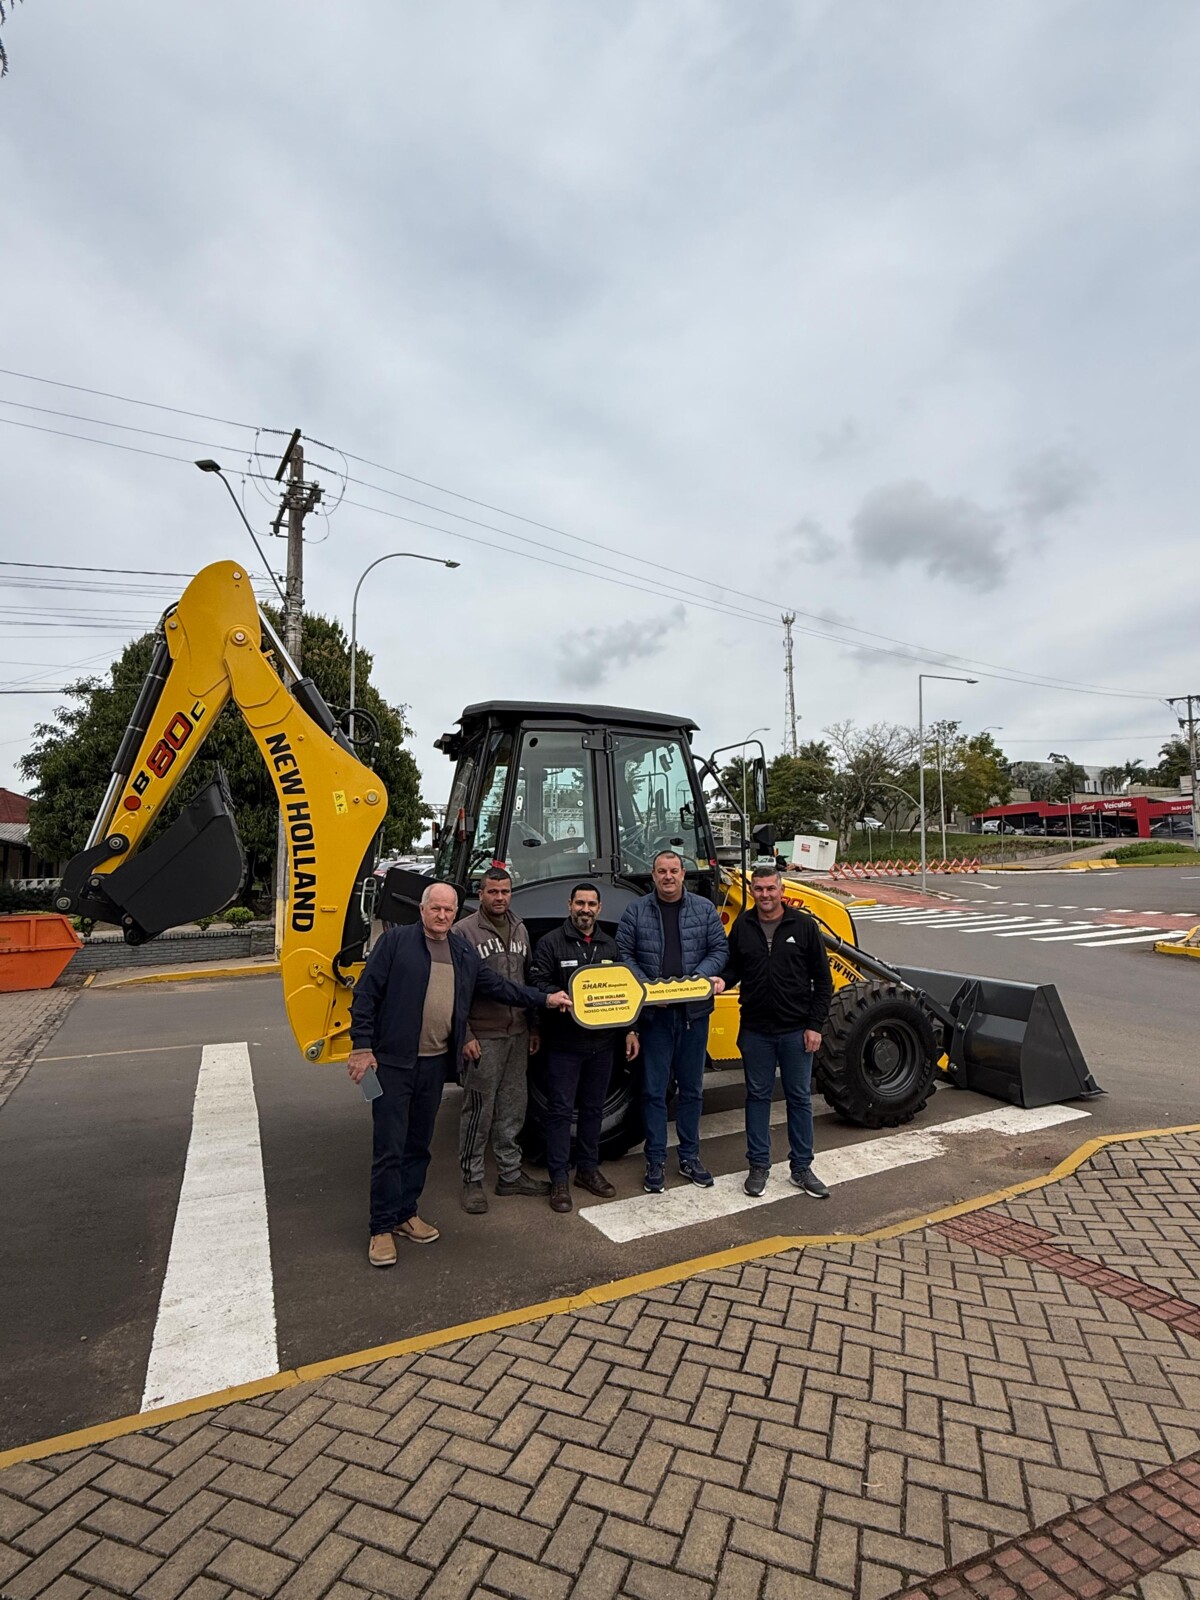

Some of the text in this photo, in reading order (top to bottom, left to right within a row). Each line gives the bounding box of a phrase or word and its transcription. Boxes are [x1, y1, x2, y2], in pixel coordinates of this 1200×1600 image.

[265, 732, 317, 933] NEW HOLLAND
[828, 957, 843, 973] EW
[581, 982, 608, 990] SHARK
